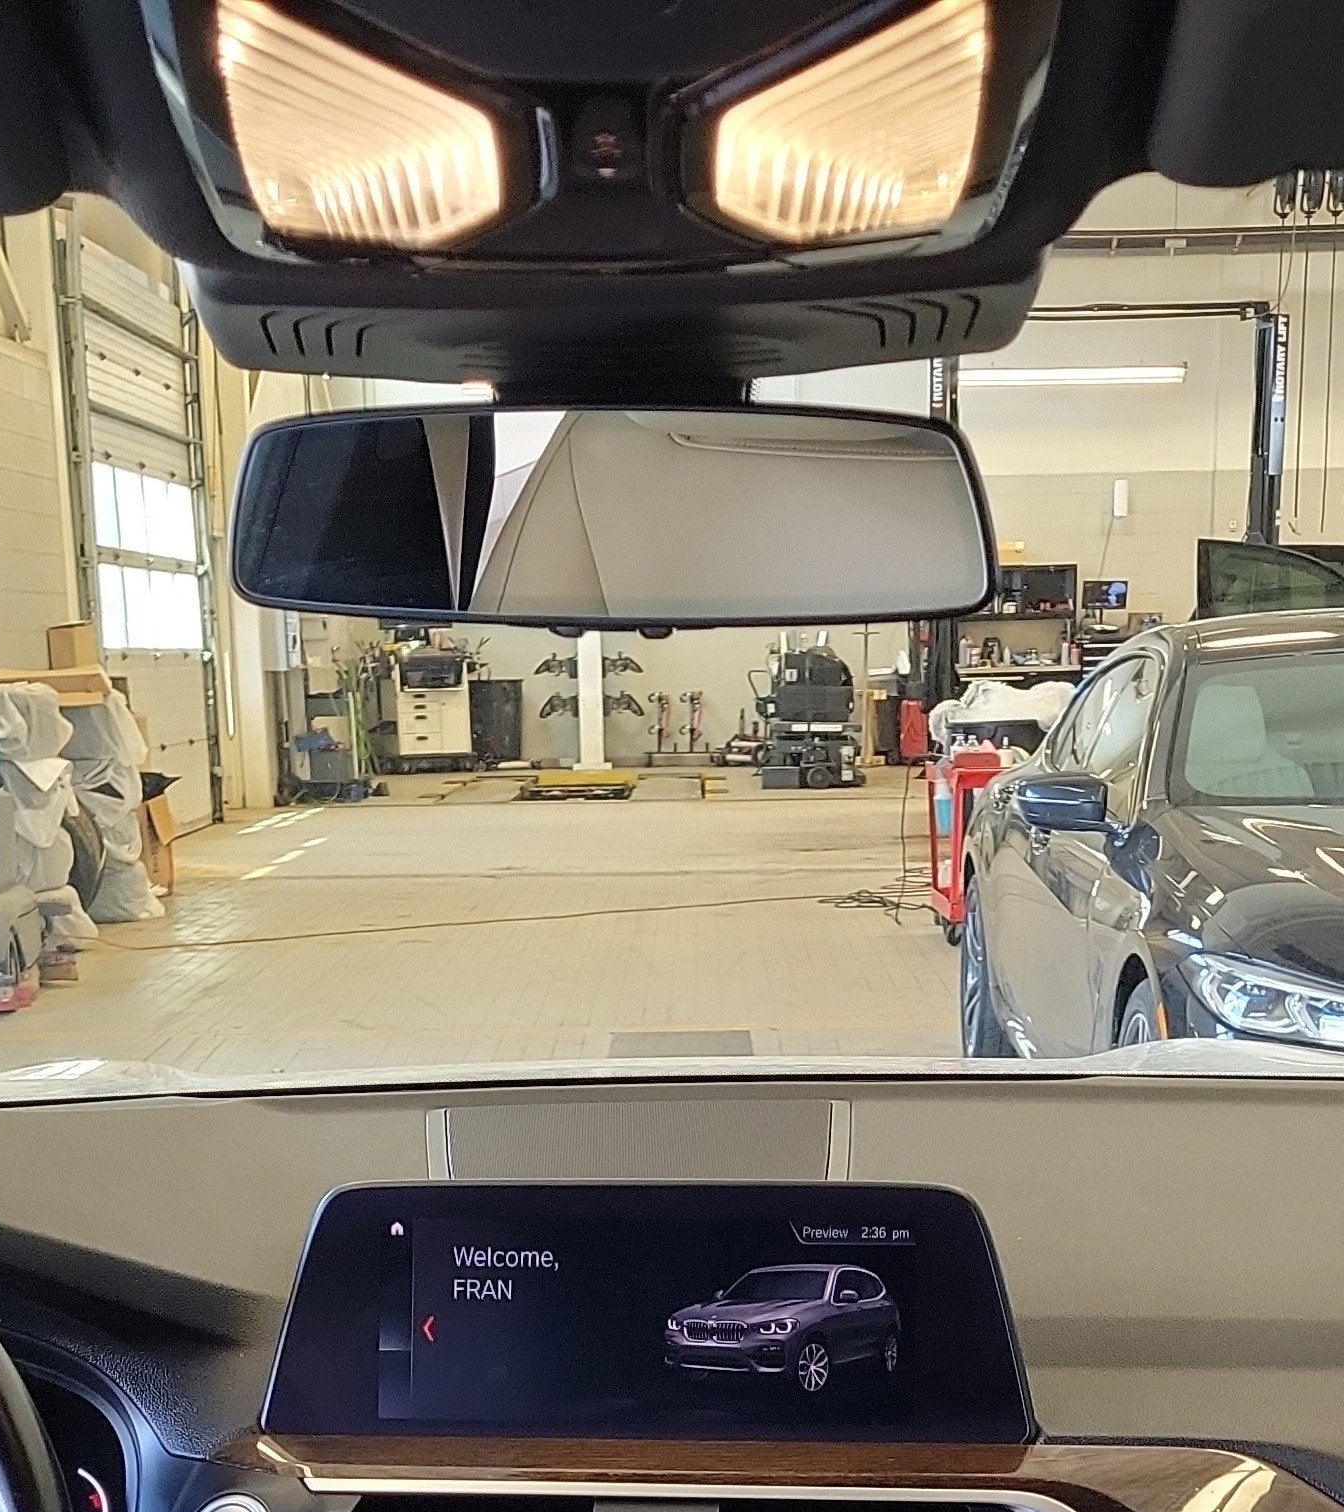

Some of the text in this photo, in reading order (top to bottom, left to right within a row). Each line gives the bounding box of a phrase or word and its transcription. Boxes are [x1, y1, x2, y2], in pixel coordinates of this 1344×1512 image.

[1277, 316, 1287, 342] LIFT
[802, 1225, 910, 1241] Preview 2:36 pm
[453, 1246, 559, 1272] Welcome,
[453, 1279, 513, 1301] FRAN
